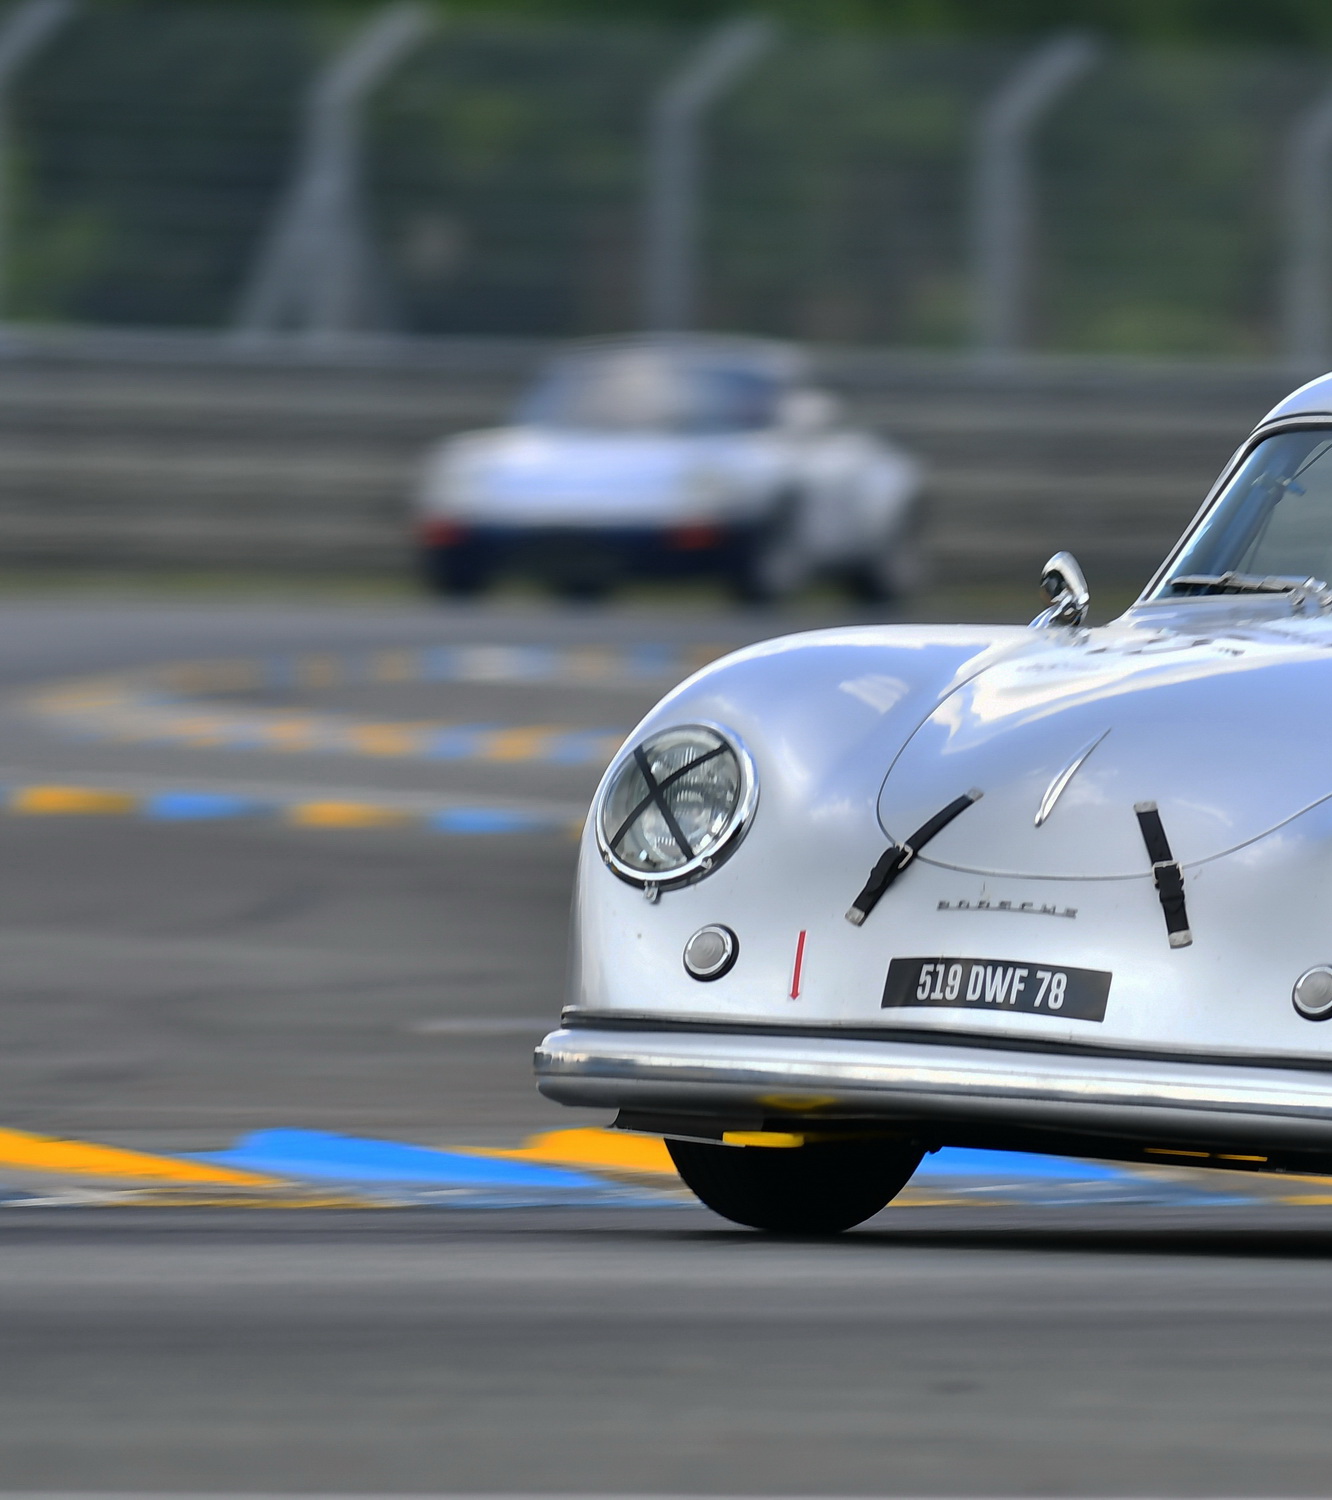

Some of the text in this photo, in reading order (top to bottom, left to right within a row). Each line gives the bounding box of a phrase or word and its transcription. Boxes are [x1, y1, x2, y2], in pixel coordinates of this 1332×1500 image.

[916, 963, 1068, 1010] 519 DWF 78
